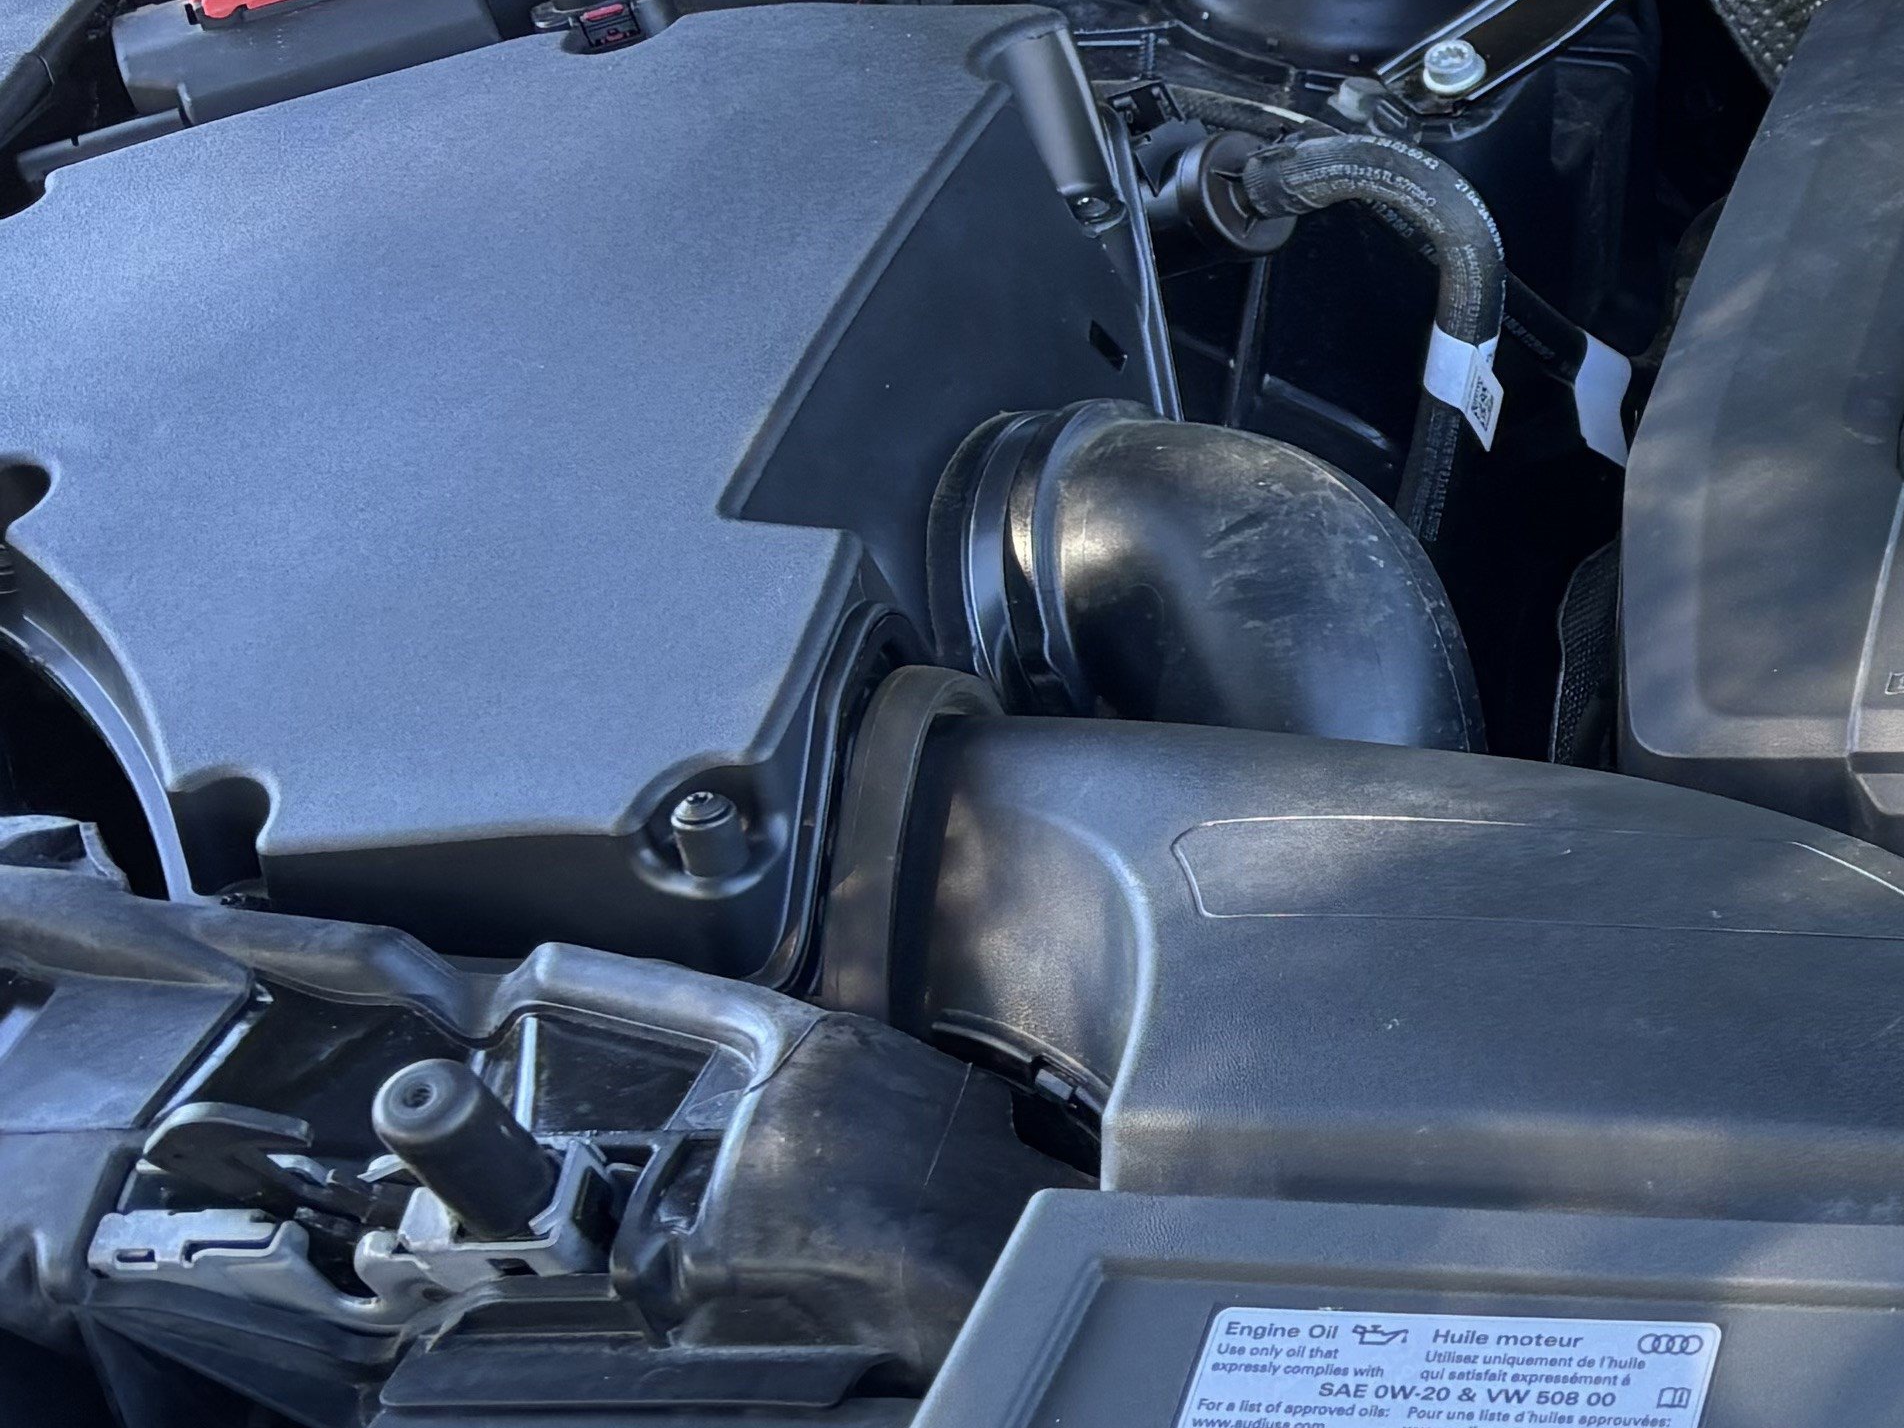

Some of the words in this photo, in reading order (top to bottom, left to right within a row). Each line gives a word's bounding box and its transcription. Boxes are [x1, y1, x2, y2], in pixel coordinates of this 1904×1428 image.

[1225, 1321, 1300, 1339] Engine
[1308, 1324, 1338, 1338] Oil
[1432, 1329, 1488, 1344] Huile
[1496, 1334, 1583, 1347] moteur
[1217, 1343, 1245, 1355] Use
[1249, 1344, 1282, 1358] only
[1285, 1345, 1306, 1357] oil
[1309, 1346, 1338, 1359] that
[1425, 1350, 1479, 1363] Utilisez
[1482, 1353, 1572, 1367] uniquement
[1576, 1355, 1595, 1368] de
[1211, 1361, 1280, 1375] expressly
[1283, 1364, 1348, 1376] complies
[1353, 1365, 1383, 1377] with
[1419, 1368, 1444, 1381] qui
[1448, 1369, 1507, 1381] satisfait
[1511, 1373, 1617, 1385] expressément
[1318, 1382, 1367, 1398] SAE
[1374, 1384, 1450, 1401] 0W-20
[1457, 1387, 1476, 1402] &
[1487, 1388, 1530, 1403] VW
[1536, 1390, 1579, 1405] 508
[1586, 1392, 1615, 1406] 00
[1197, 1397, 1223, 1410] For
[1225, 1402, 1235, 1411] a
[1238, 1399, 1262, 1412] list
[1264, 1401, 1282, 1413] of
[1284, 1404, 1355, 1416] approved
[1358, 1405, 1390, 1417] oils:
[1406, 1406, 1442, 1419] Pour
[1446, 1411, 1474, 1420] une
[1479, 1409, 1510, 1421] liste
